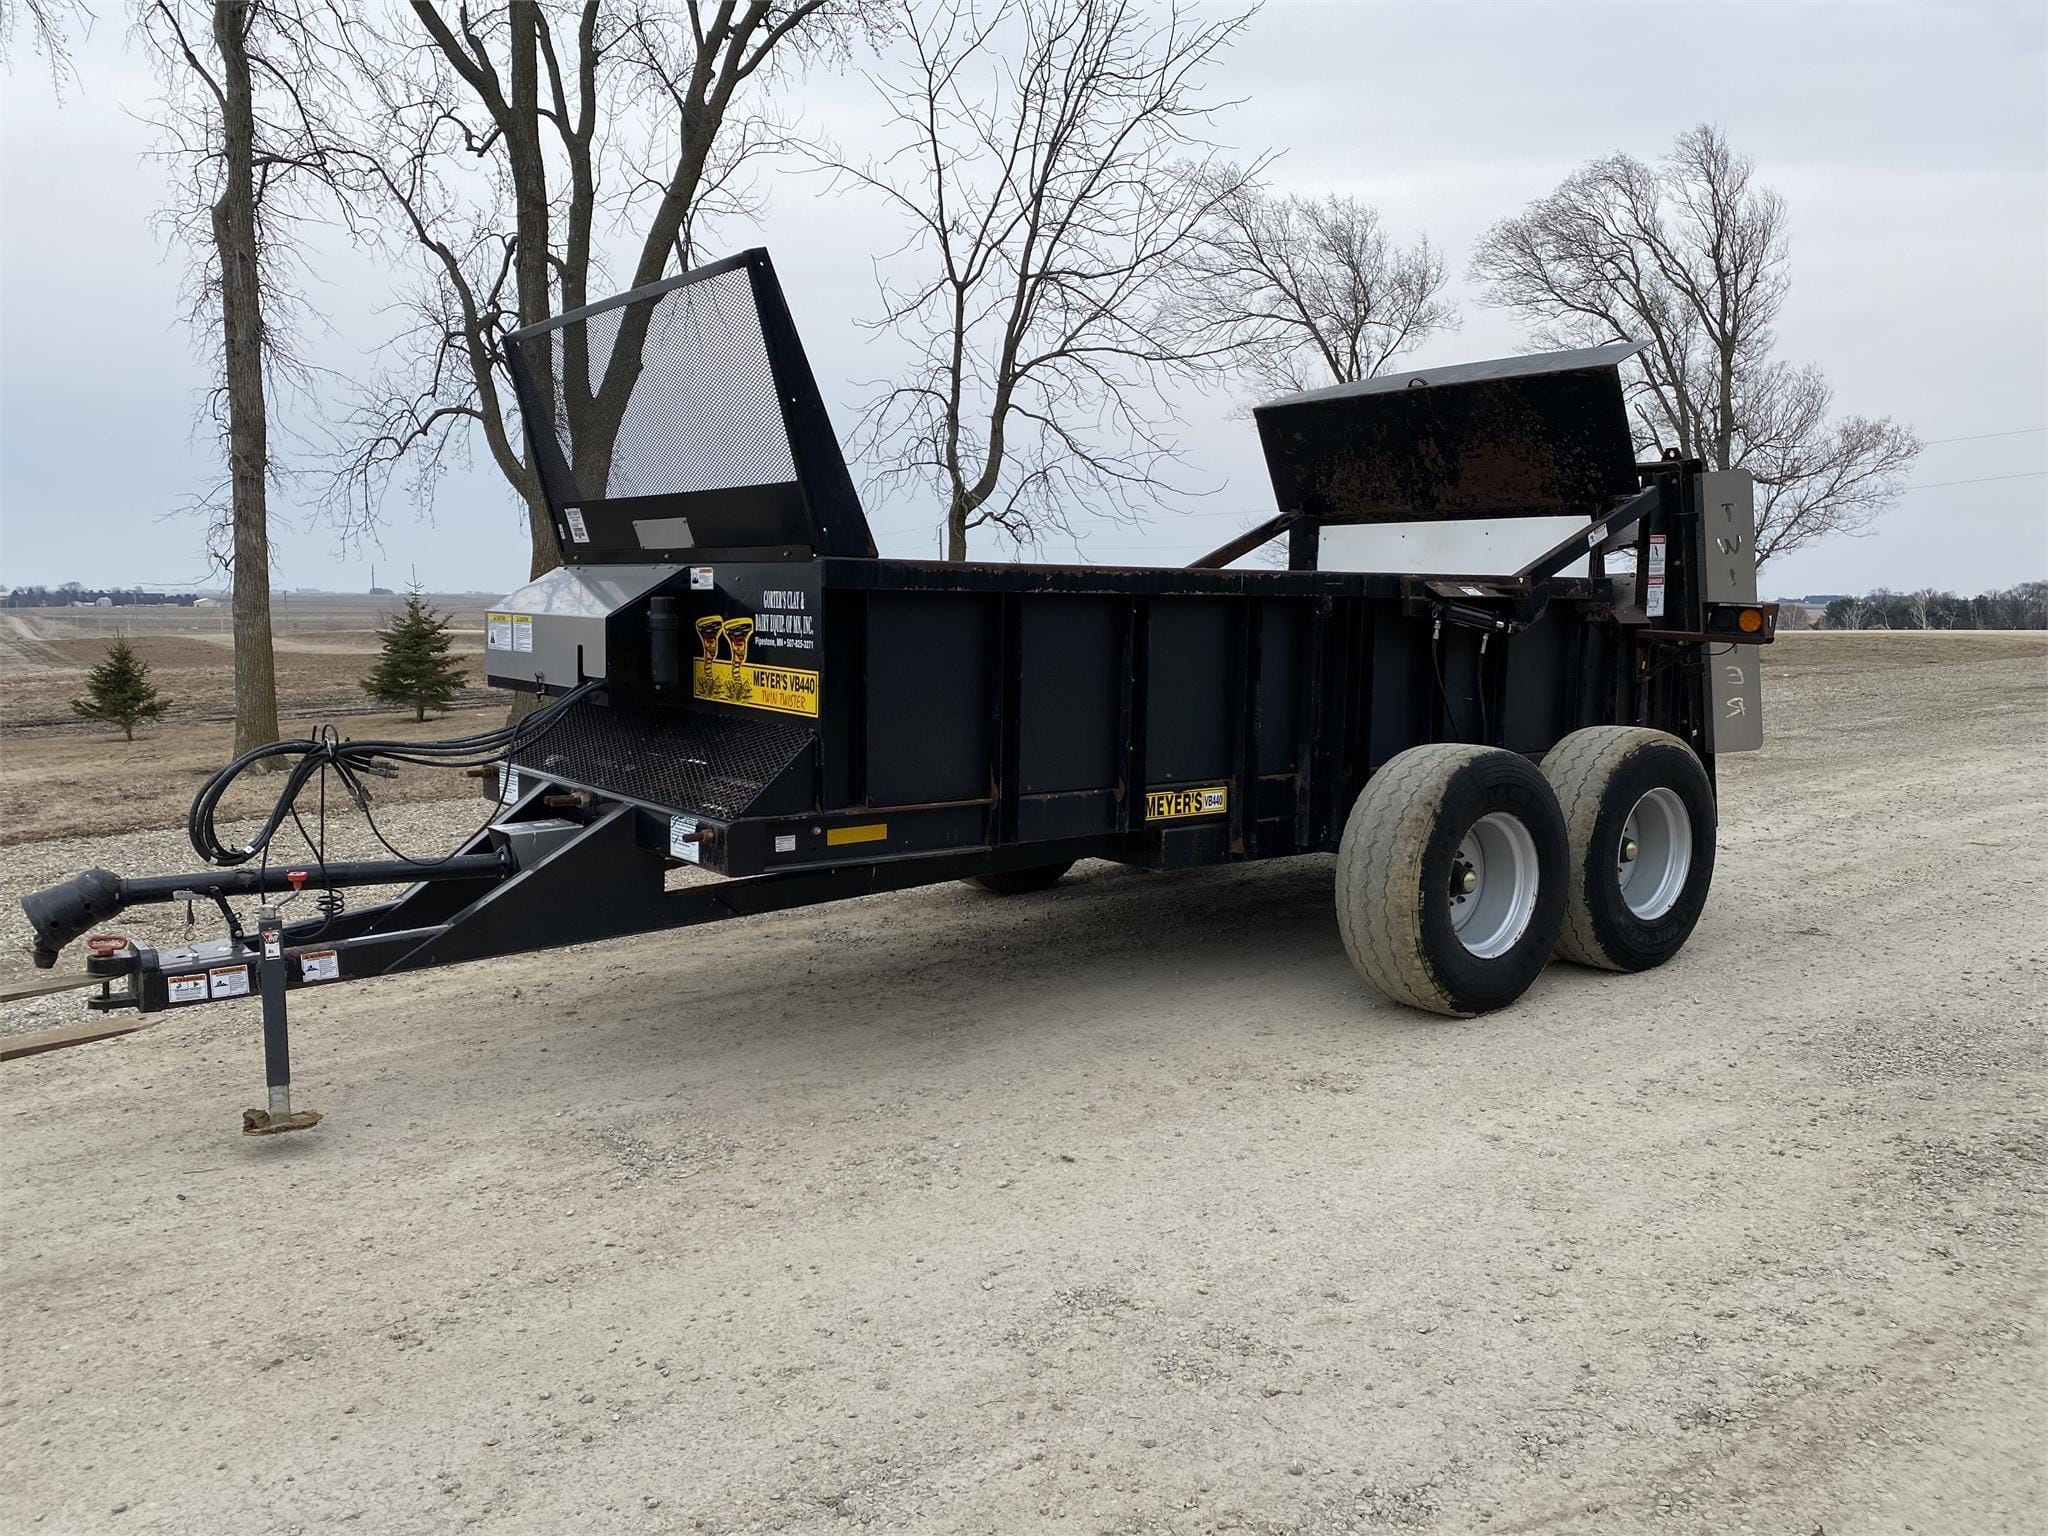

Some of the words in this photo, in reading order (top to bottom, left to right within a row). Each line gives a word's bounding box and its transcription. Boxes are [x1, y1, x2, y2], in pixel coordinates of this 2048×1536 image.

[787, 590, 800, 610] CLAY
[755, 613, 769, 632] DAIRY
[785, 614, 793, 634] OF
[803, 615, 814, 635] INC.
[753, 670, 788, 691] MEYER'S
[789, 674, 816, 695] VB440
[761, 690, 778, 704] TWIN
[779, 692, 806, 710] TWISTER
[1146, 792, 1203, 817] MEYER'S
[1204, 793, 1224, 807] VB440
